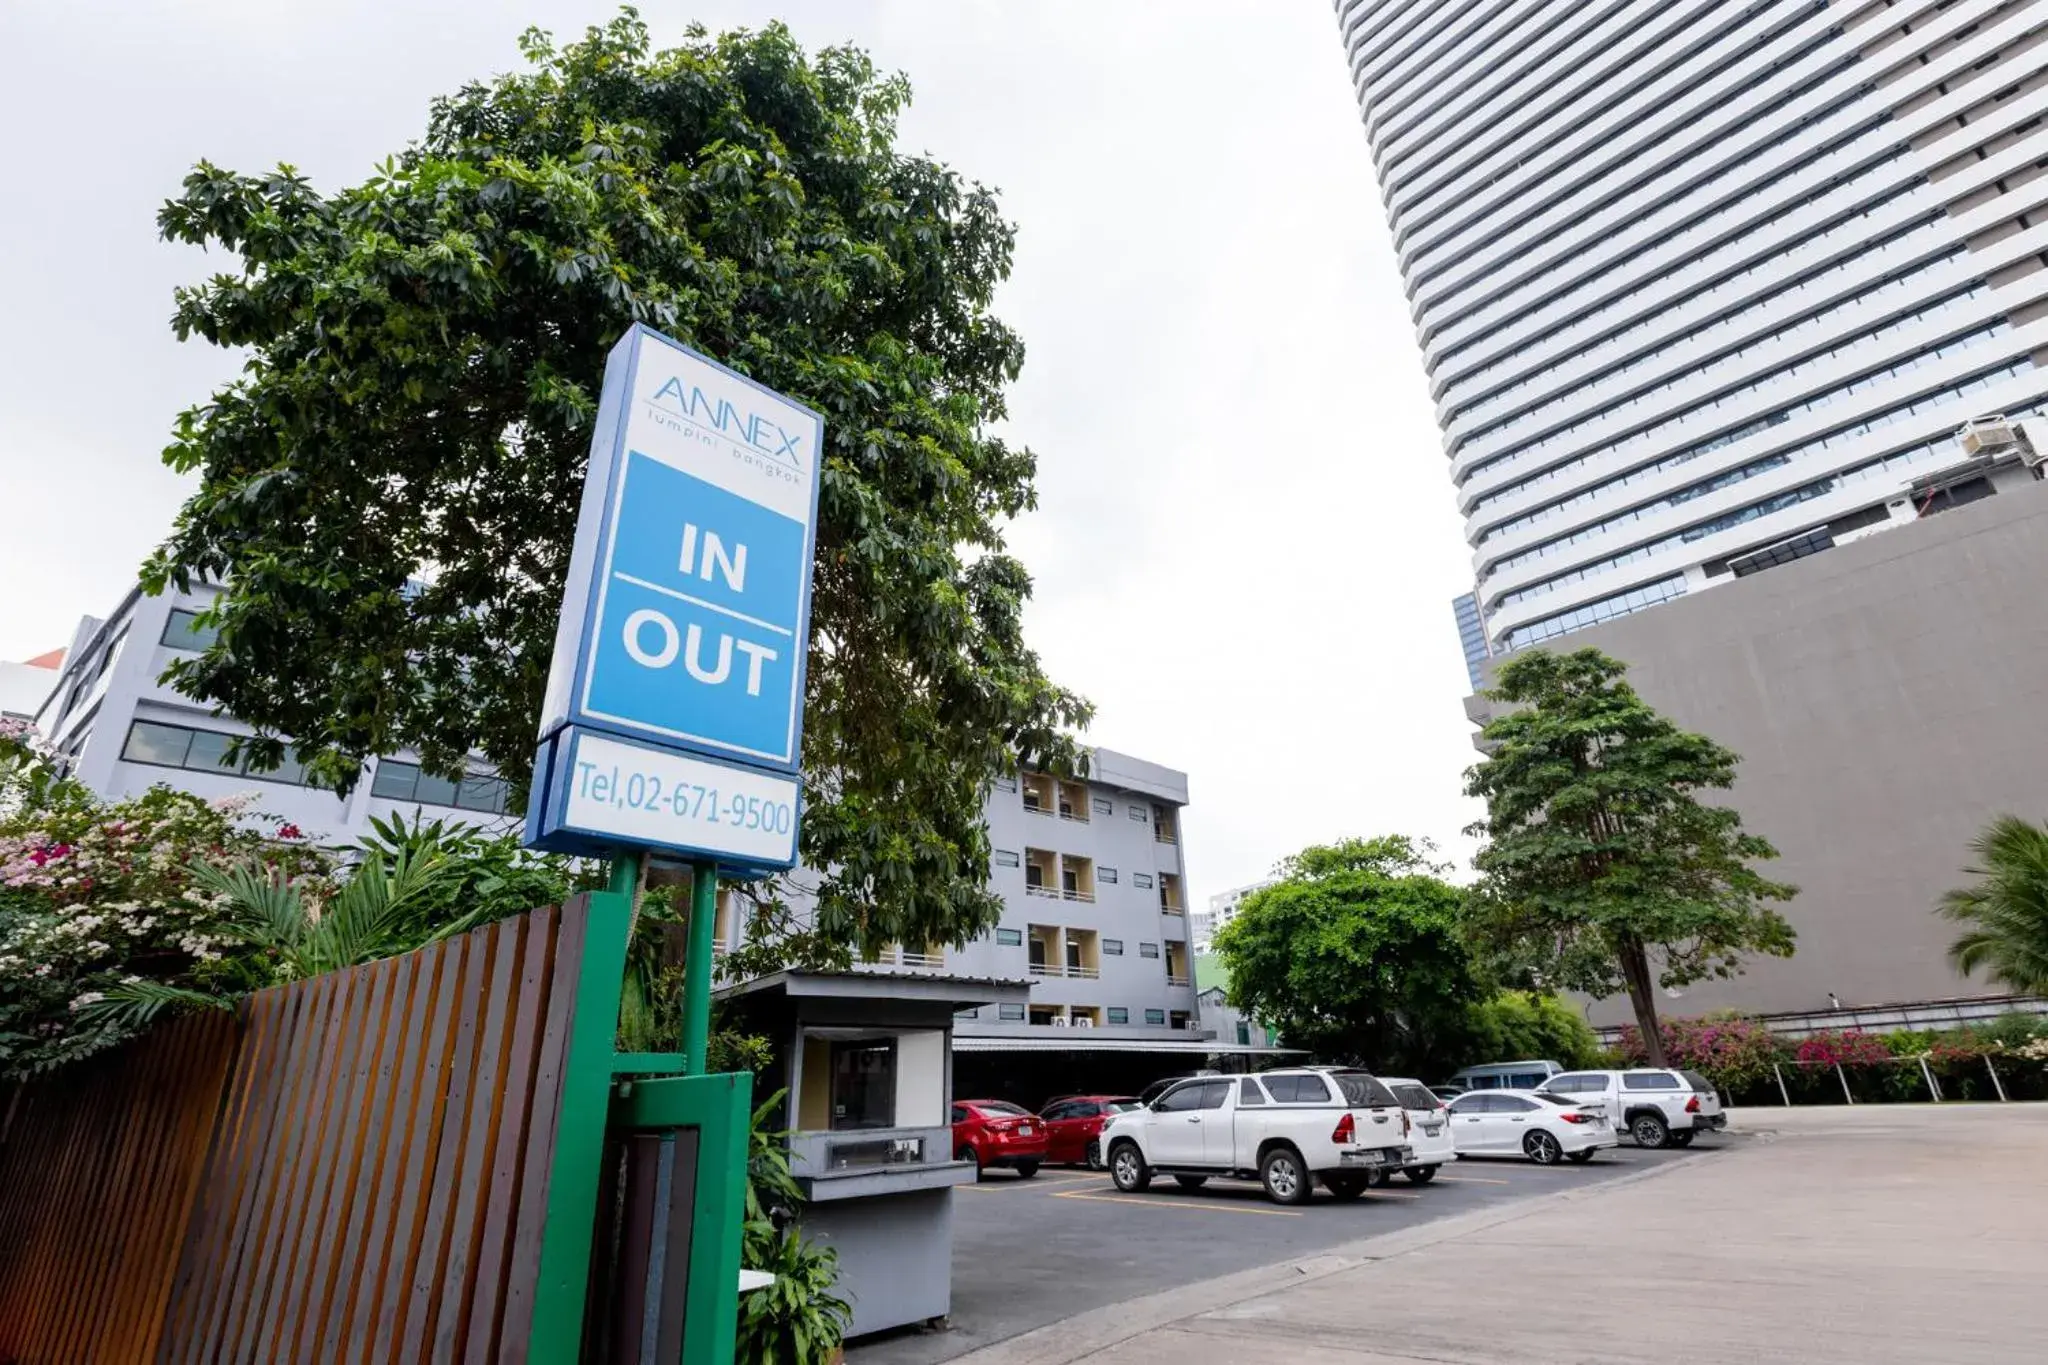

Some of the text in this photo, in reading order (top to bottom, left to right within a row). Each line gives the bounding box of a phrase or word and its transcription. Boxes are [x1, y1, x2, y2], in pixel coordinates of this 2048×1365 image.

[648, 409, 801, 484] lumpini bangkok
[653, 376, 801, 465] ANNEX
[679, 524, 747, 592] IN
[623, 609, 777, 696] OUT
